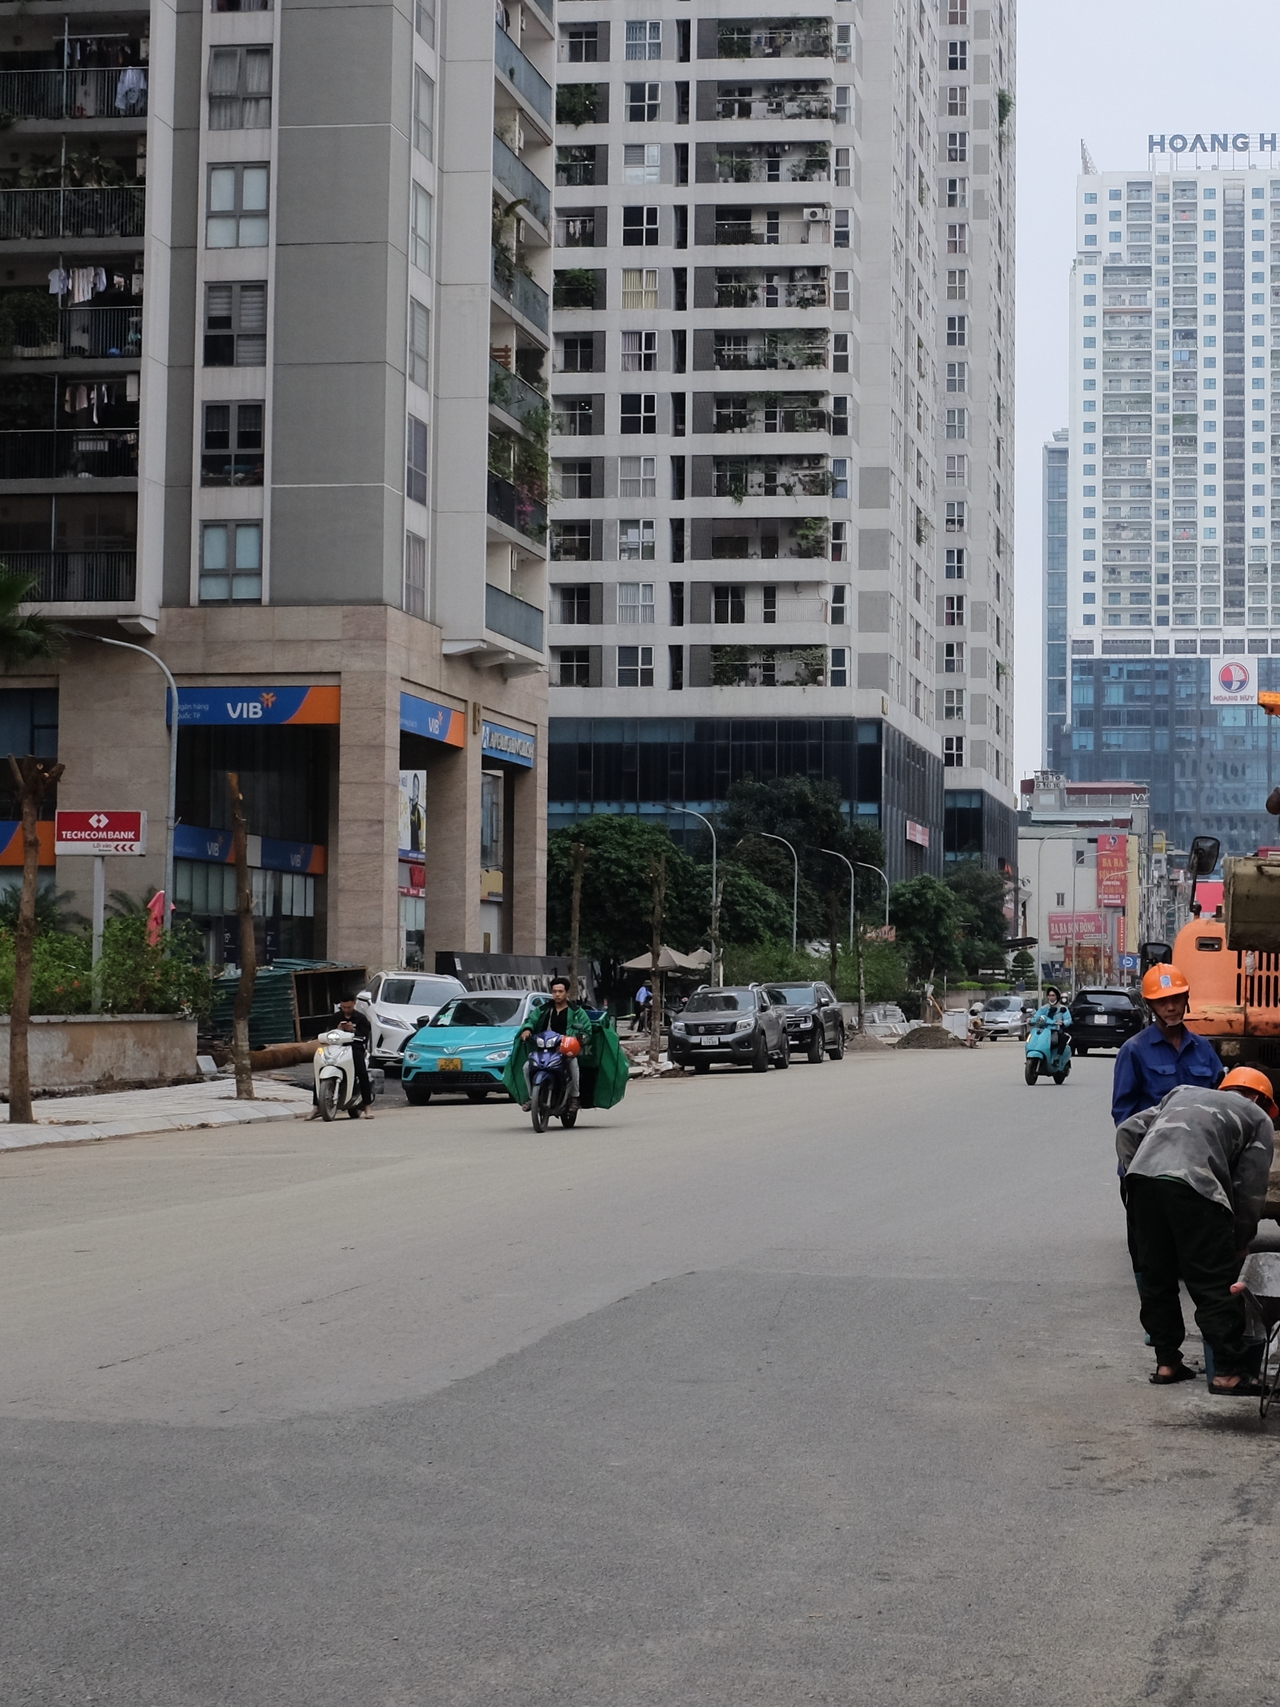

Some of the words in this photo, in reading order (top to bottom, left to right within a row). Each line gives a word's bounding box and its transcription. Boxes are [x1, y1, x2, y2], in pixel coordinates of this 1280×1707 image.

[1149, 133, 1250, 153] HOANG
[226, 702, 263, 719] VIB
[428, 716, 440, 734] VIB
[61, 830, 135, 839] TECHCOMBANK
[206, 842, 220, 856] VIB
[290, 854, 302, 867] VIB
[1102, 858, 1112, 868] BA
[1113, 858, 1124, 868] BA
